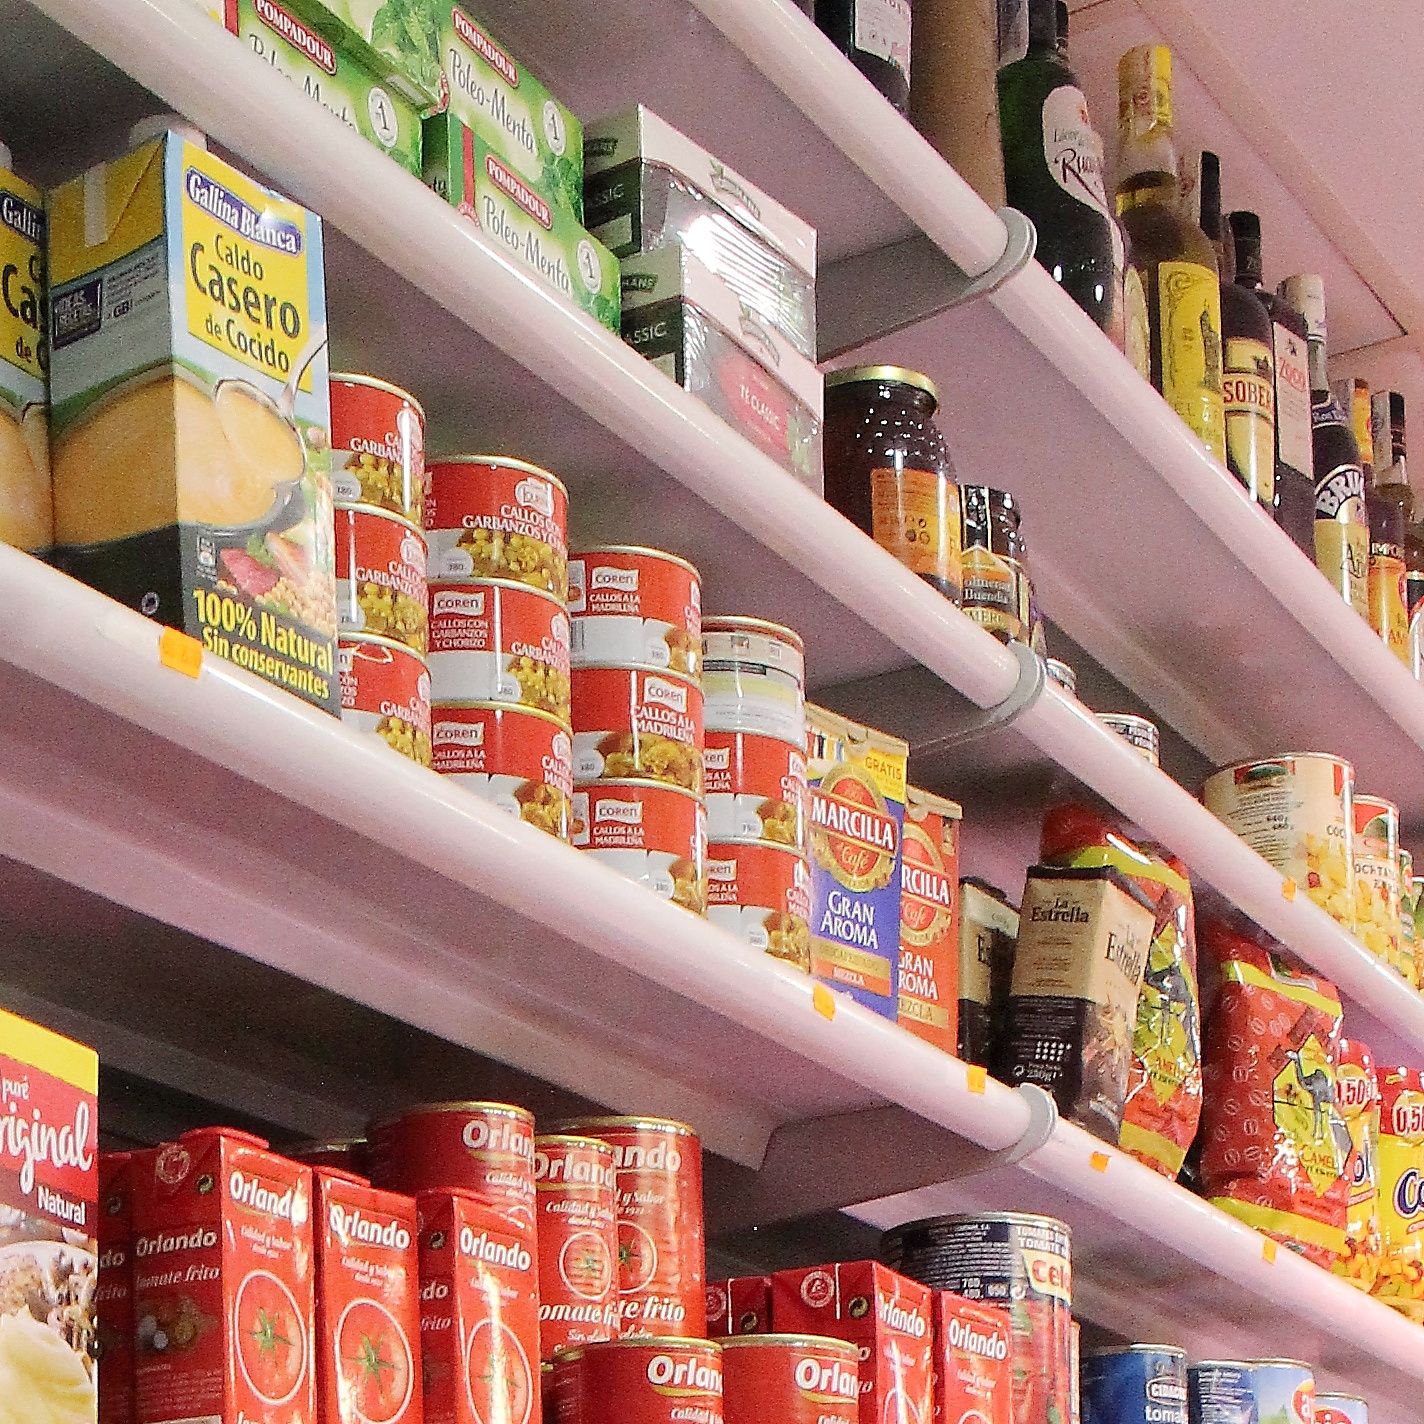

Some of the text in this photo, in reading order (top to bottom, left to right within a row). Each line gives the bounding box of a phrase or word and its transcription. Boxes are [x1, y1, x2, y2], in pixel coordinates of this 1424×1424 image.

[453, 10, 517, 85] POMPADOUR
[447, 49, 538, 155] Poleo-Menta
[187, 173, 299, 253] Gallina Blanca
[487, 156, 552, 228] POMPADOUR
[214, 233, 264, 282] Caldo
[482, 196, 571, 292] Poleo-Menta
[190, 247, 302, 340] Casero
[204, 315, 290, 373] de Cocido
[194, 588, 334, 675] 100% Natural
[202, 629, 330, 700] Sin conservantes
[865, 756, 903, 781] GRATIS
[812, 800, 894, 851] MARCILLA
[842, 847, 870, 872] Café
[828, 891, 875, 923] GRAN
[1032, 907, 1089, 924] Estrella
[821, 915, 878, 950] AROMA
[2, 1075, 30, 1102] puré
[36, 1186, 86, 1224] Natural
[229, 1171, 307, 1224] Orlando
[135, 1228, 218, 1257] Orlando
[330, 1205, 409, 1249] Orlando
[460, 1228, 531, 1270] Orlando
[182, 1264, 219, 1283] frito
[639, 1302, 685, 1324] frito
[878, 1295, 926, 1338] Orlando
[949, 1318, 1008, 1361] Orlando
